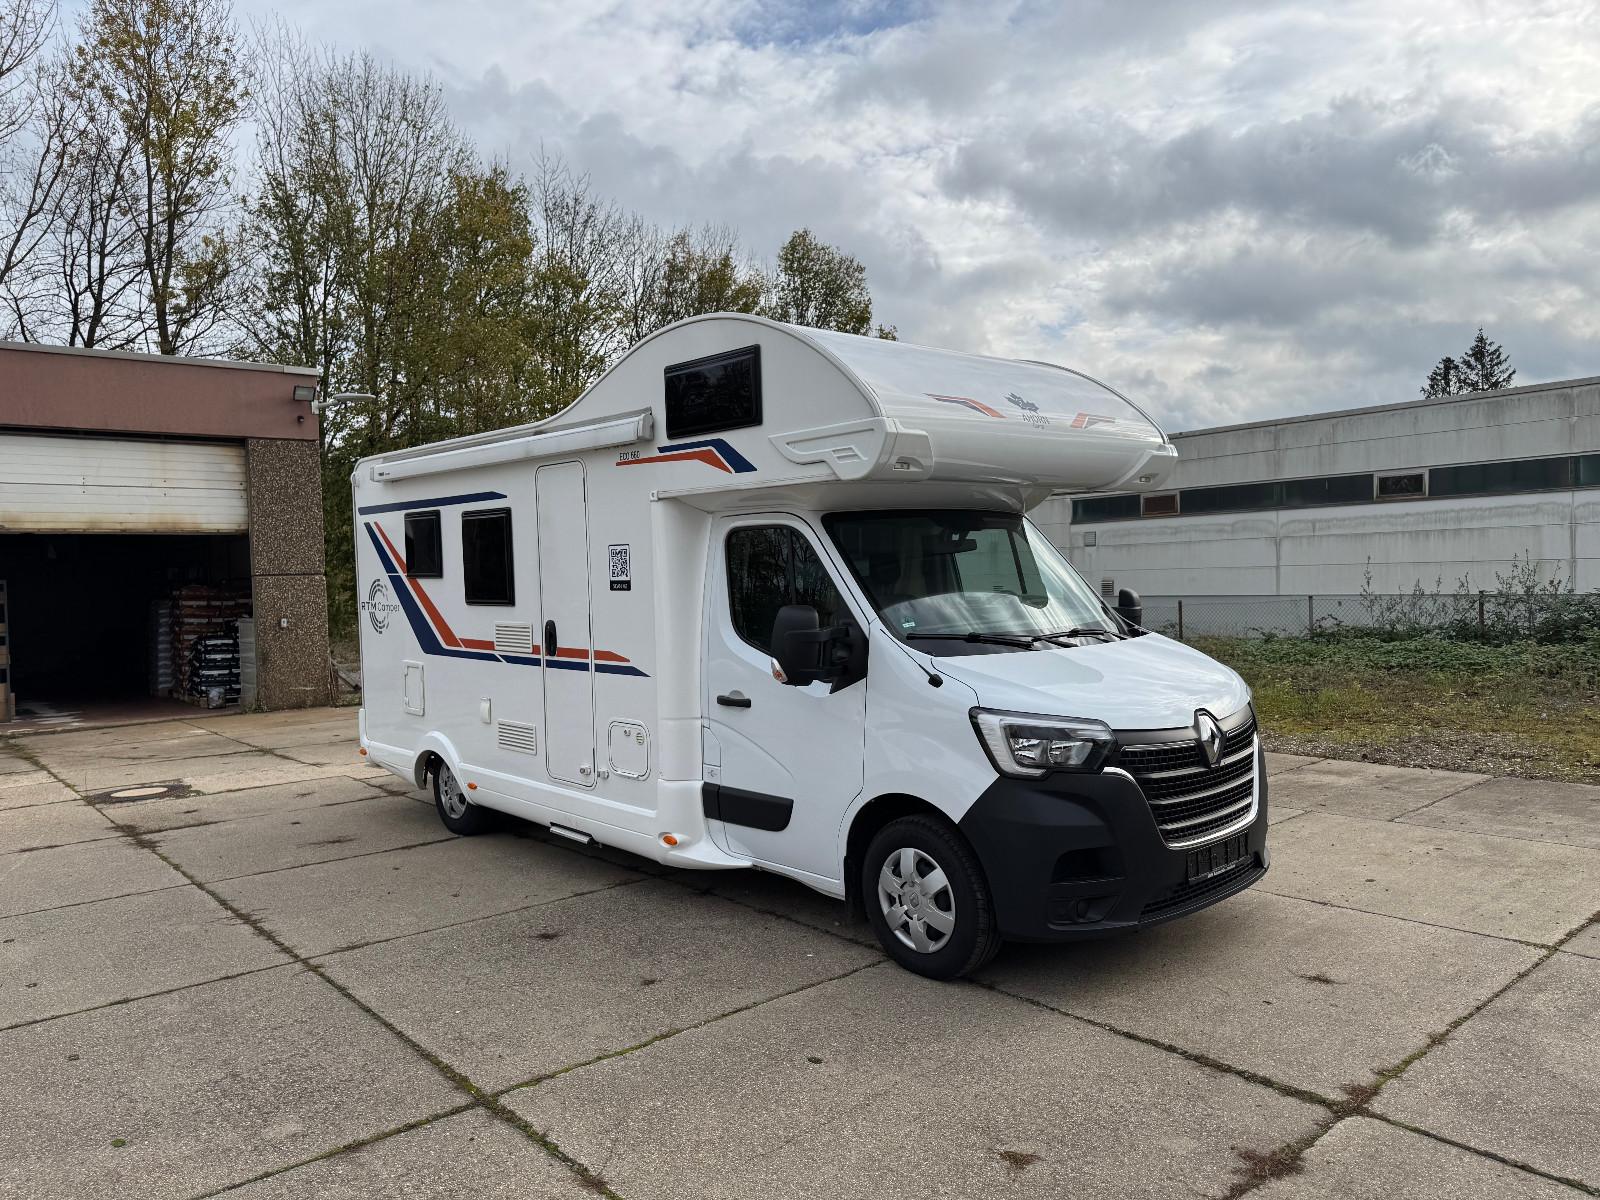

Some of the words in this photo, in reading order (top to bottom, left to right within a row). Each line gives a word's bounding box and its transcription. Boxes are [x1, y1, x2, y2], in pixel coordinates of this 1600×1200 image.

[1022, 413, 1050, 425] AHORN
[360, 601, 377, 611] RTM
[378, 601, 400, 613] Camper
